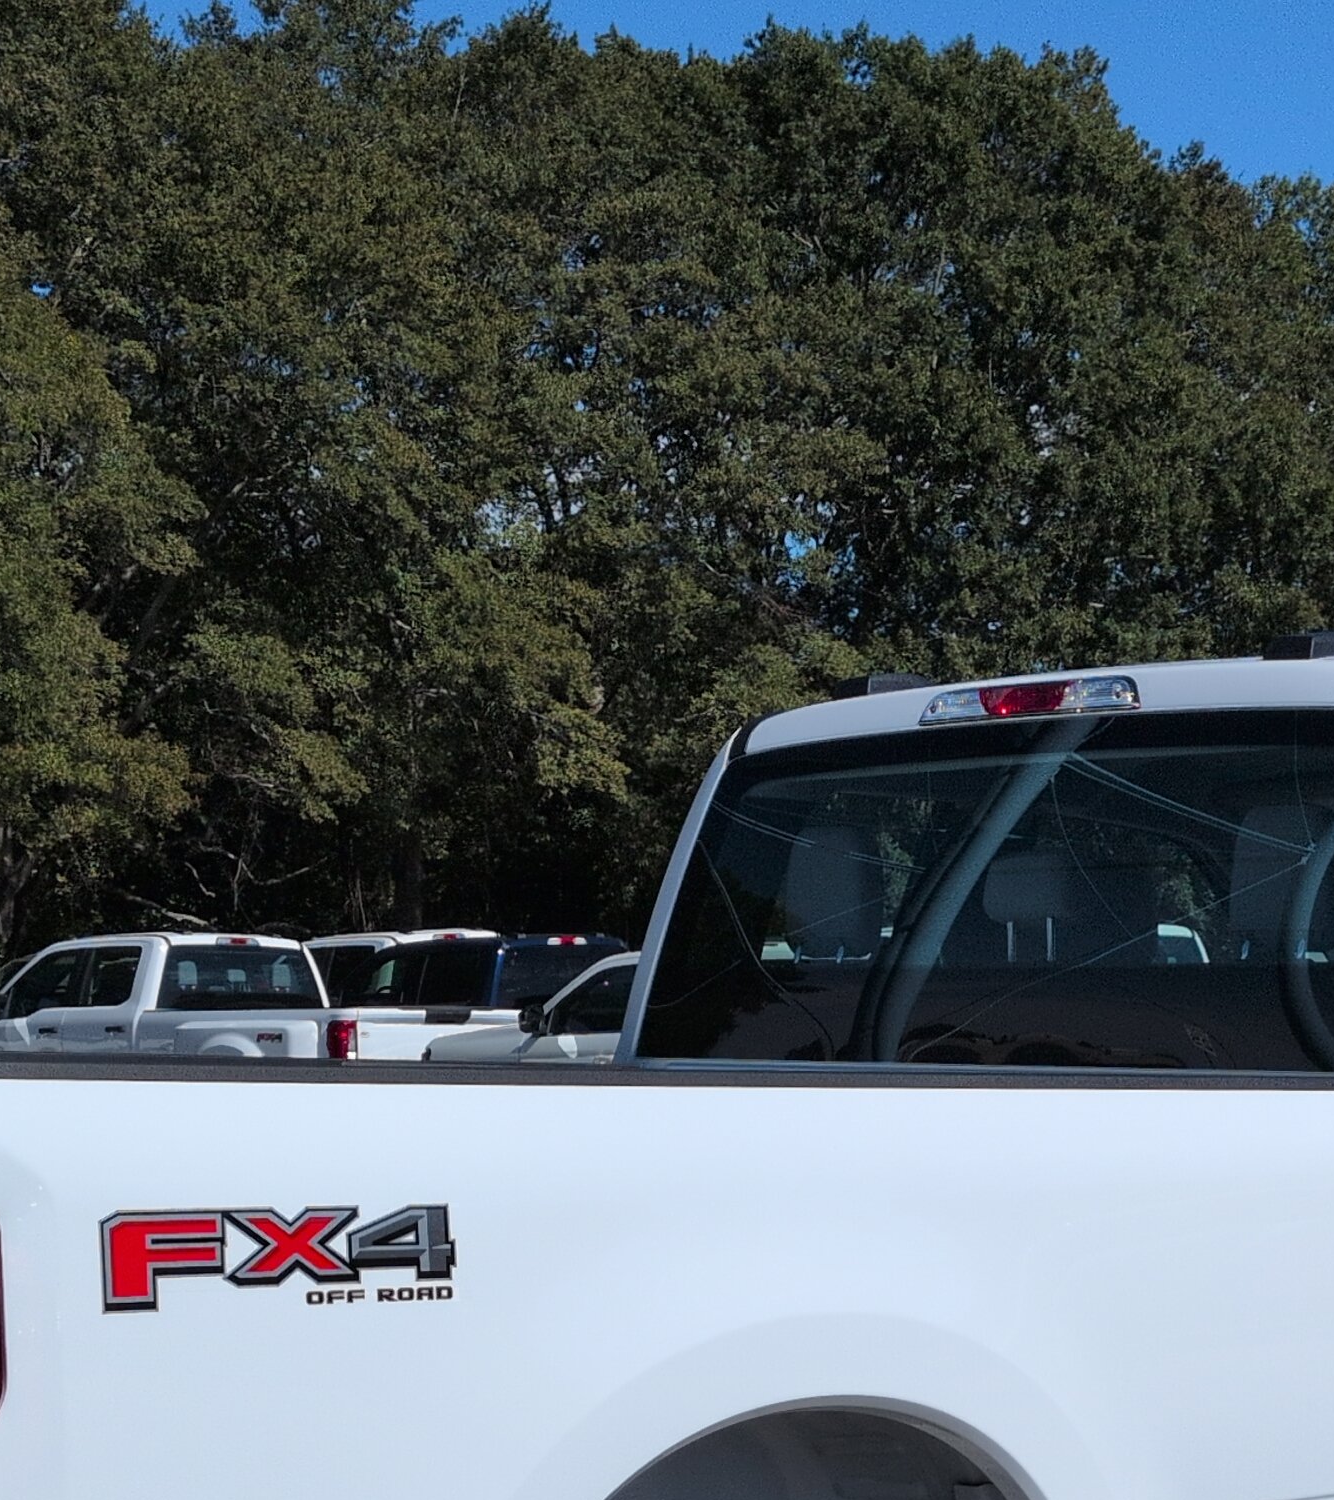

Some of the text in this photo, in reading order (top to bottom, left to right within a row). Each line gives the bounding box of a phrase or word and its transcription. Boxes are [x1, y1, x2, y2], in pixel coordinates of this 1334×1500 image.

[99, 1203, 457, 1314] FX4
[306, 1285, 454, 1305] OFF ROAD
